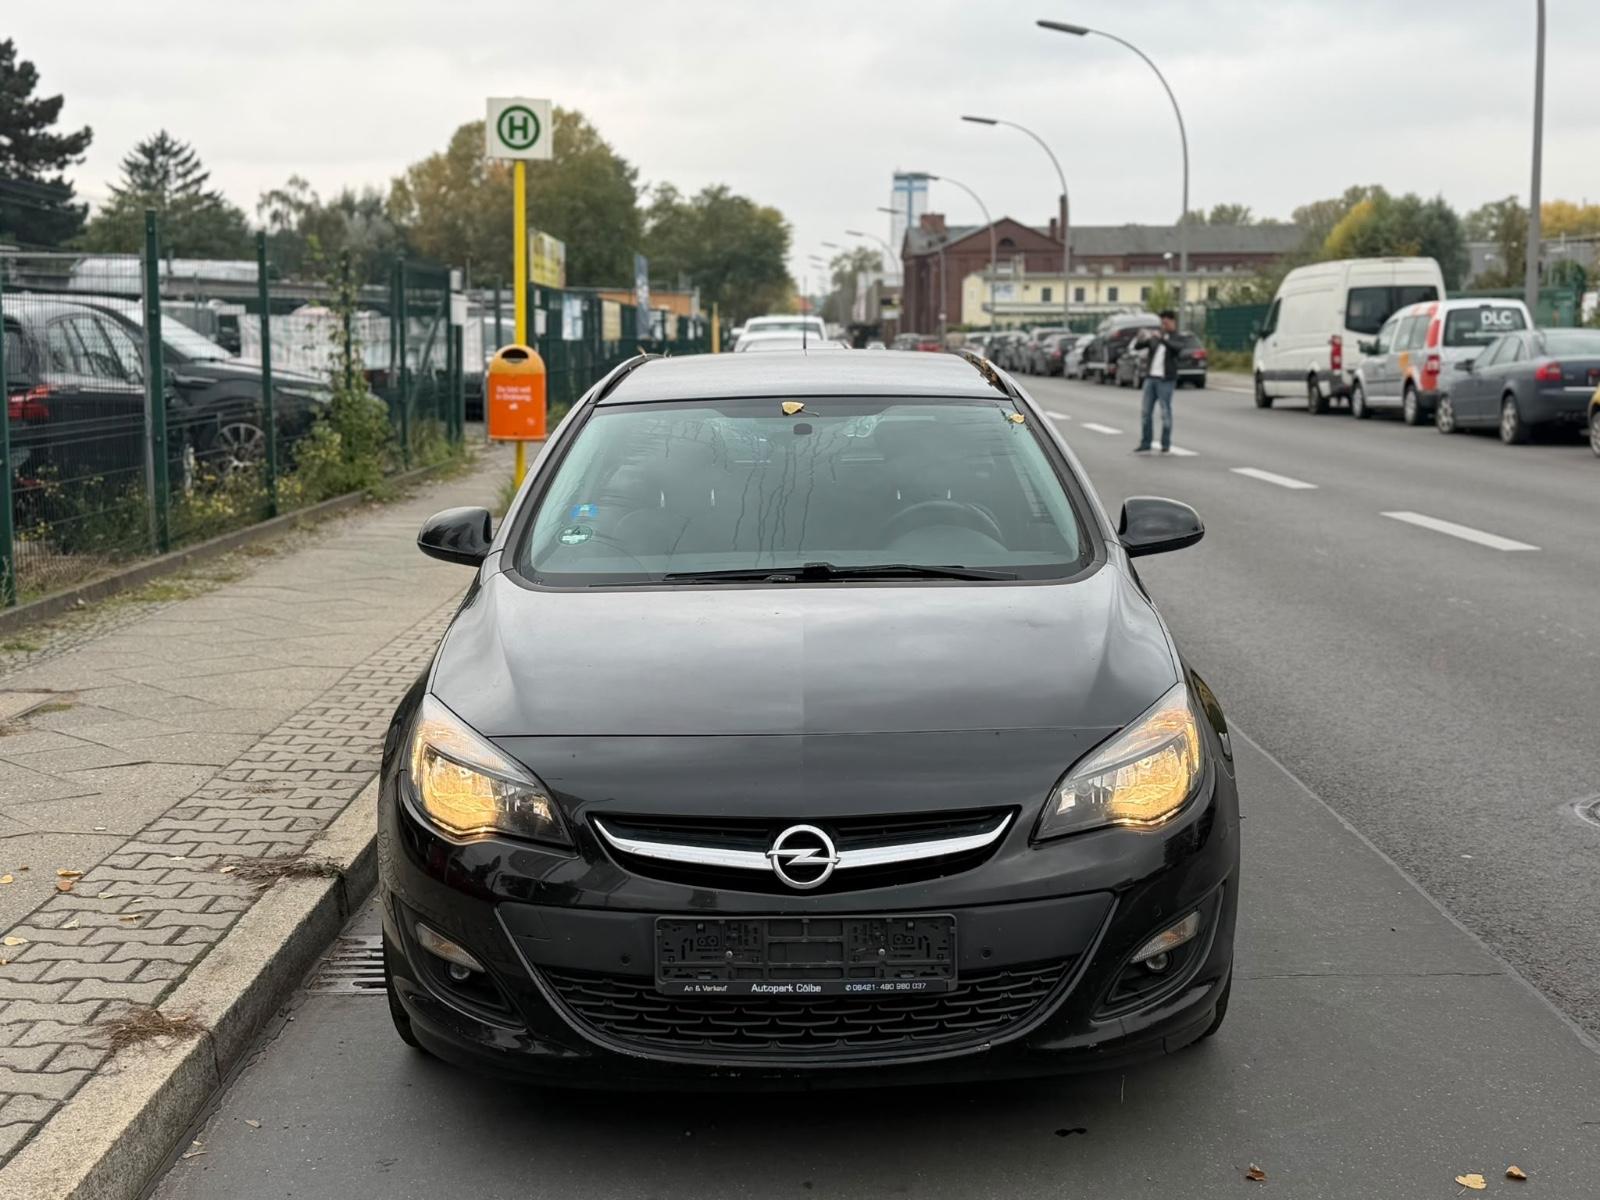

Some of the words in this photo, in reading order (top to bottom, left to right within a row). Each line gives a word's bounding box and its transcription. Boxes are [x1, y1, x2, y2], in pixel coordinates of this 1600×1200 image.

[508, 115, 529, 140] H
[1481, 310, 1512, 324] DLC
[751, 983, 793, 994] Autopark
[796, 983, 822, 993] Cölbe
